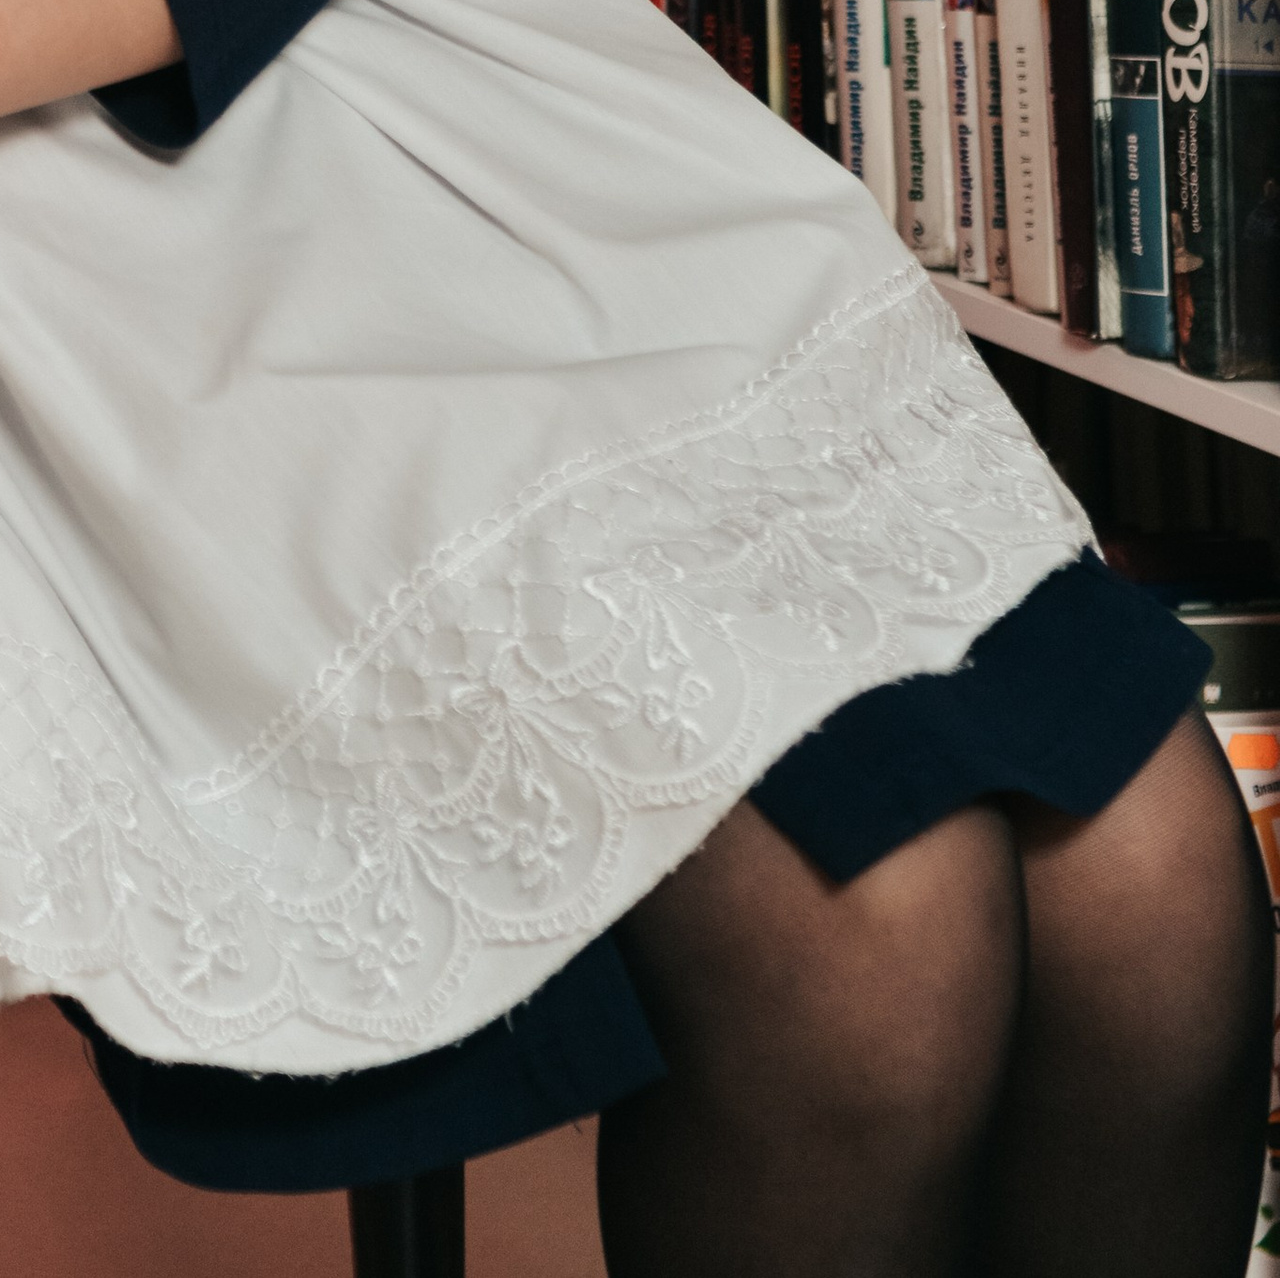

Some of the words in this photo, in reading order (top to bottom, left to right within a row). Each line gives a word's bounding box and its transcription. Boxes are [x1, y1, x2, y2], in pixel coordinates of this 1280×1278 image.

[845, 0, 862, 72] Найдин
[903, 17, 920, 91] Найдин
[953, 40, 968, 117] Найдин
[847, 80, 865, 181] ладимир
[908, 98, 924, 202] Владимир
[1127, 133, 1139, 181] ОРЛОВ
[1178, 129, 1189, 211] переулок
[957, 124, 972, 228] Владимир
[1189, 108, 1202, 234] Камергерский
[1129, 188, 1144, 256] ДАНИЭЛЬ
